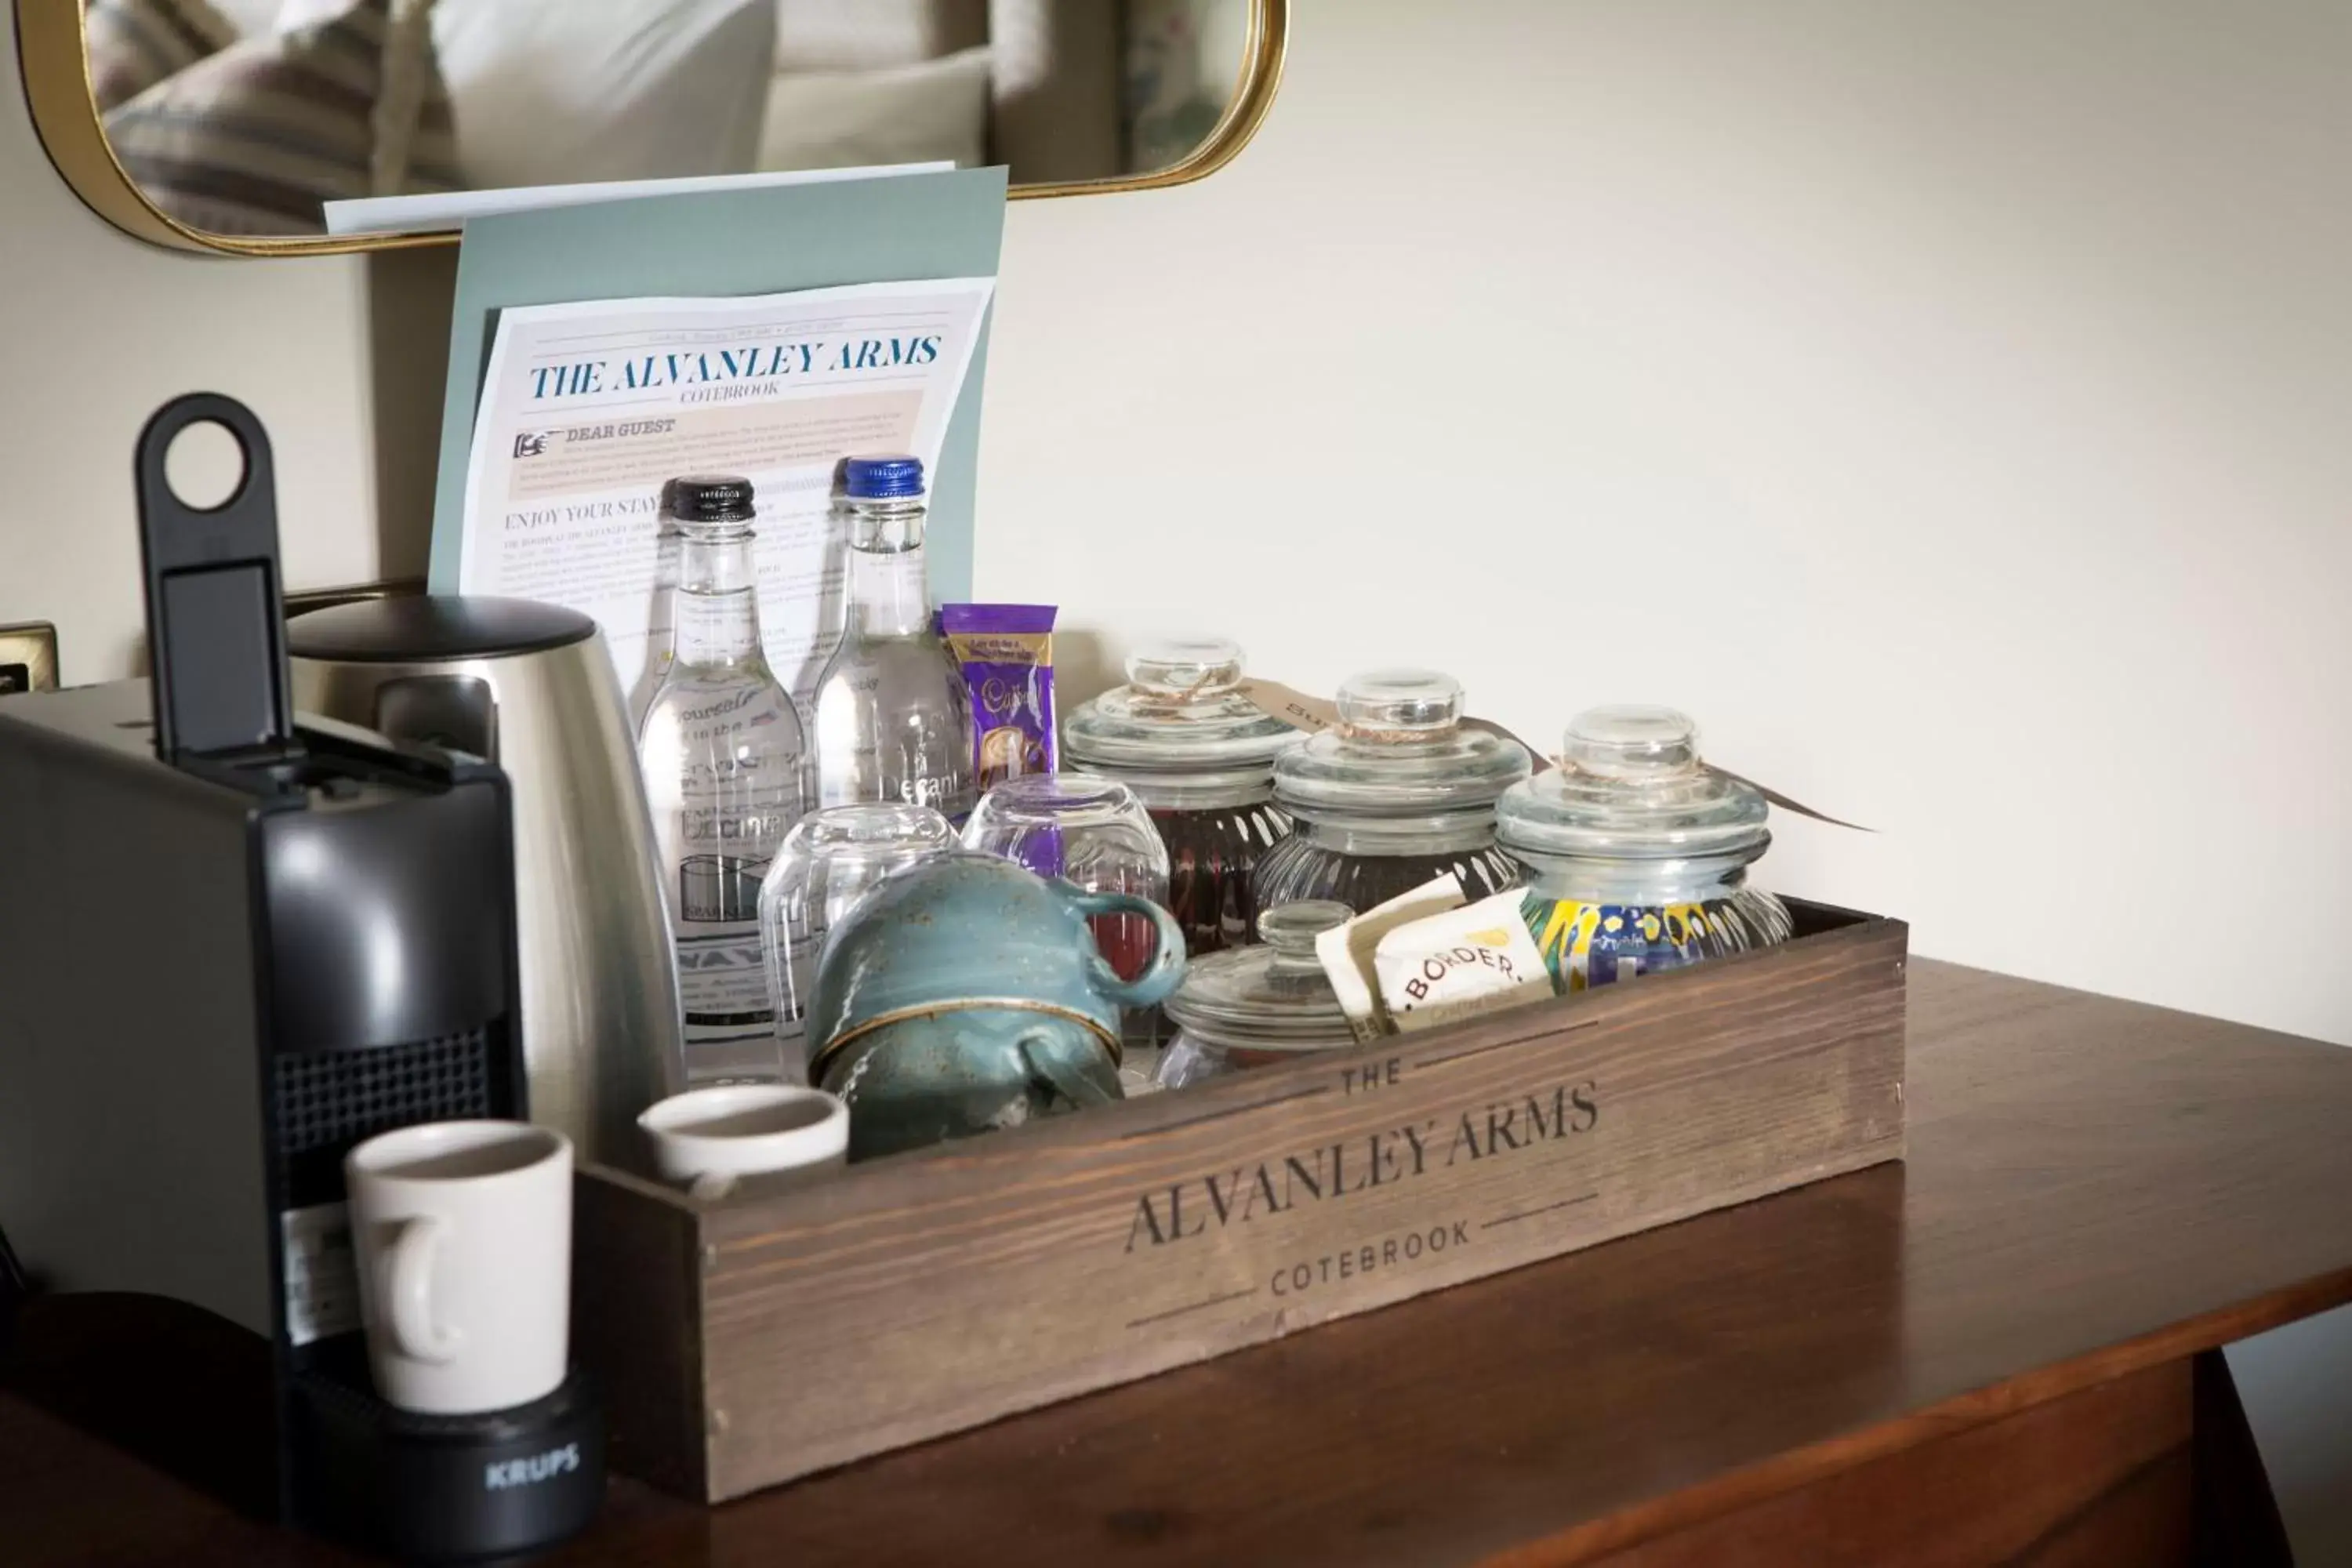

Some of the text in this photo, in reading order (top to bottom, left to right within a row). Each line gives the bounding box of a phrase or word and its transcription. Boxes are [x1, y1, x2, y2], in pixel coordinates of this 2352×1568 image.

[530, 335, 942, 399] THE ALVANLEY ARMS
[679, 381, 780, 403] COTEBROOK
[565, 423, 615, 442] DEAR
[617, 419, 677, 437] GUEST
[505, 495, 661, 530] ENJOY YOUR STAY
[1406, 946, 1513, 1000] BORDER
[1341, 1058, 1402, 1094] THE
[1124, 1080, 1599, 1254] ALVANLEY ARMS
[1271, 1220, 1469, 1296] COTEBROOK
[485, 1443, 580, 1490] KRUPS
